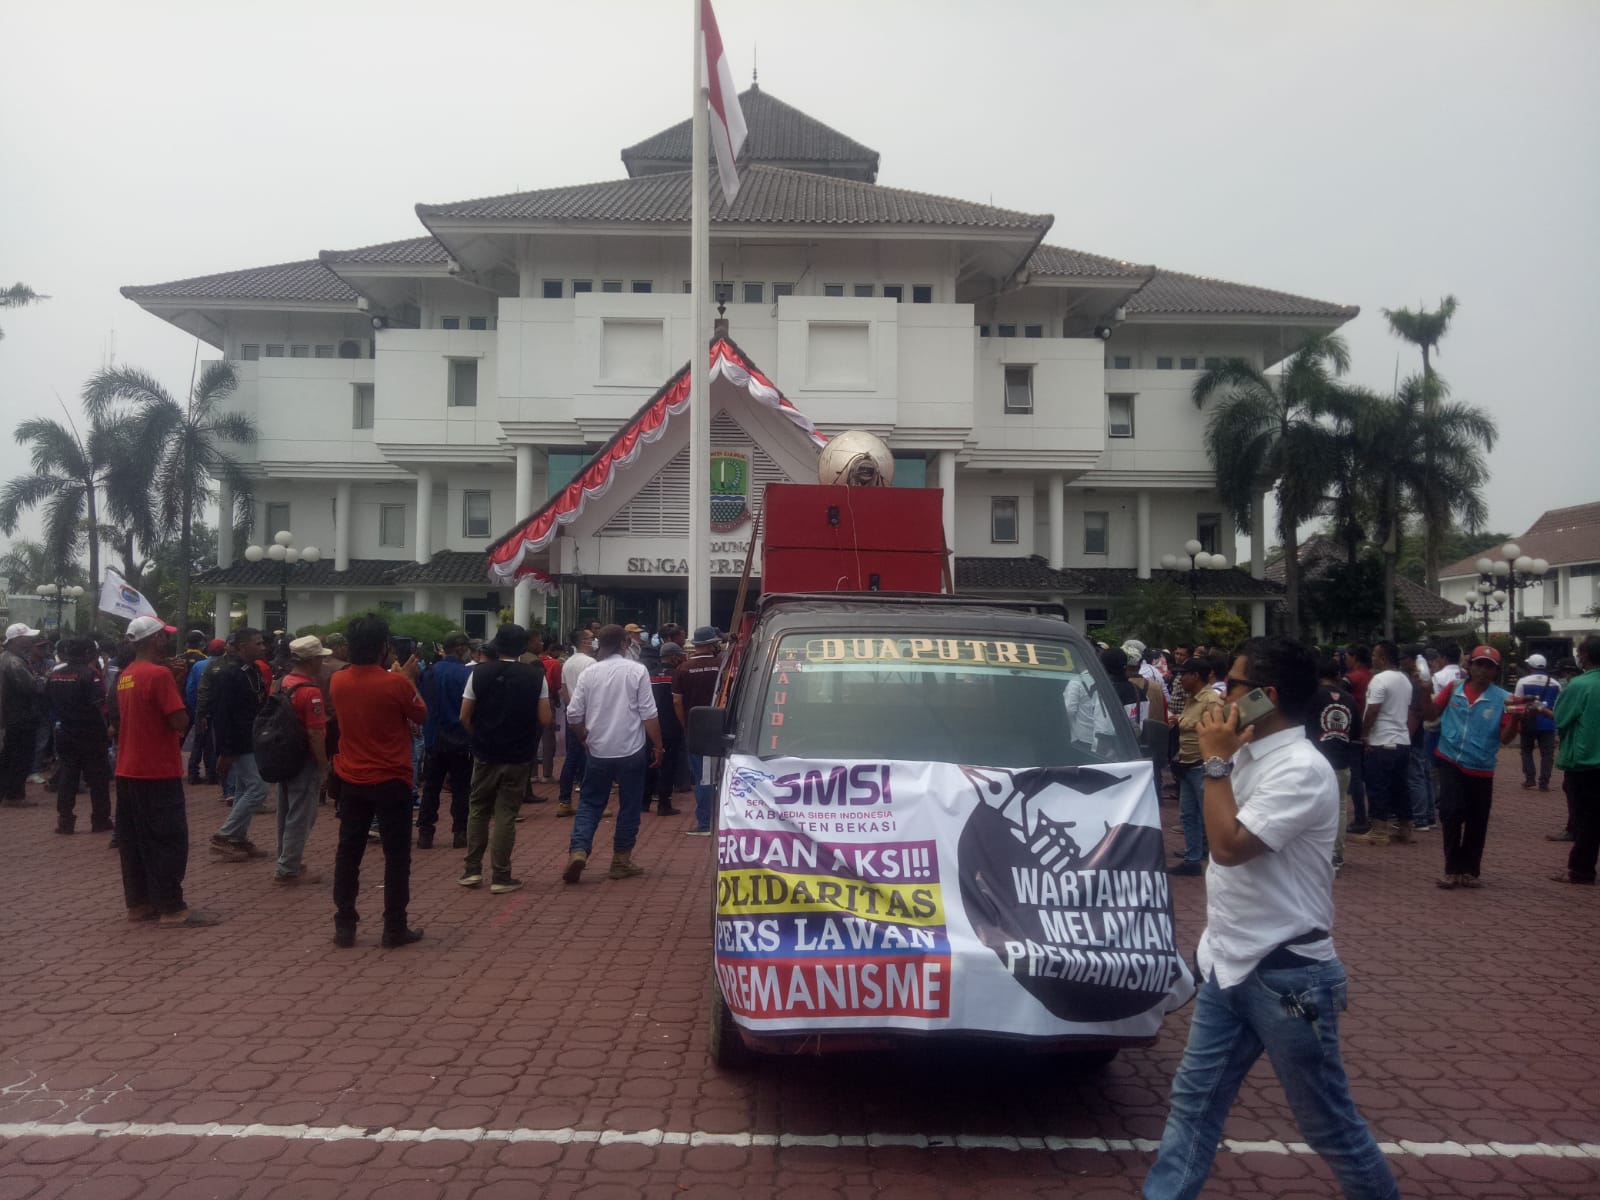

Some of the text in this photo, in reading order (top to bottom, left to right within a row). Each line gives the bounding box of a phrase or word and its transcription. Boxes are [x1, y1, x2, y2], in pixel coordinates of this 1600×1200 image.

[822, 638, 1040, 665] DUA PUTRI
[773, 764, 893, 806] SMSI
[808, 811, 837, 820] SIBER
[839, 810, 893, 820] INDONESIA
[835, 820, 897, 833] BEKASI
[831, 847, 931, 879] AKSI!!
[1011, 866, 1168, 908] WARTAWAN
[717, 917, 936, 953] PERS LAWAN
[1038, 909, 1175, 951] MELAWAN
[720, 962, 941, 1012] PREMANISME
